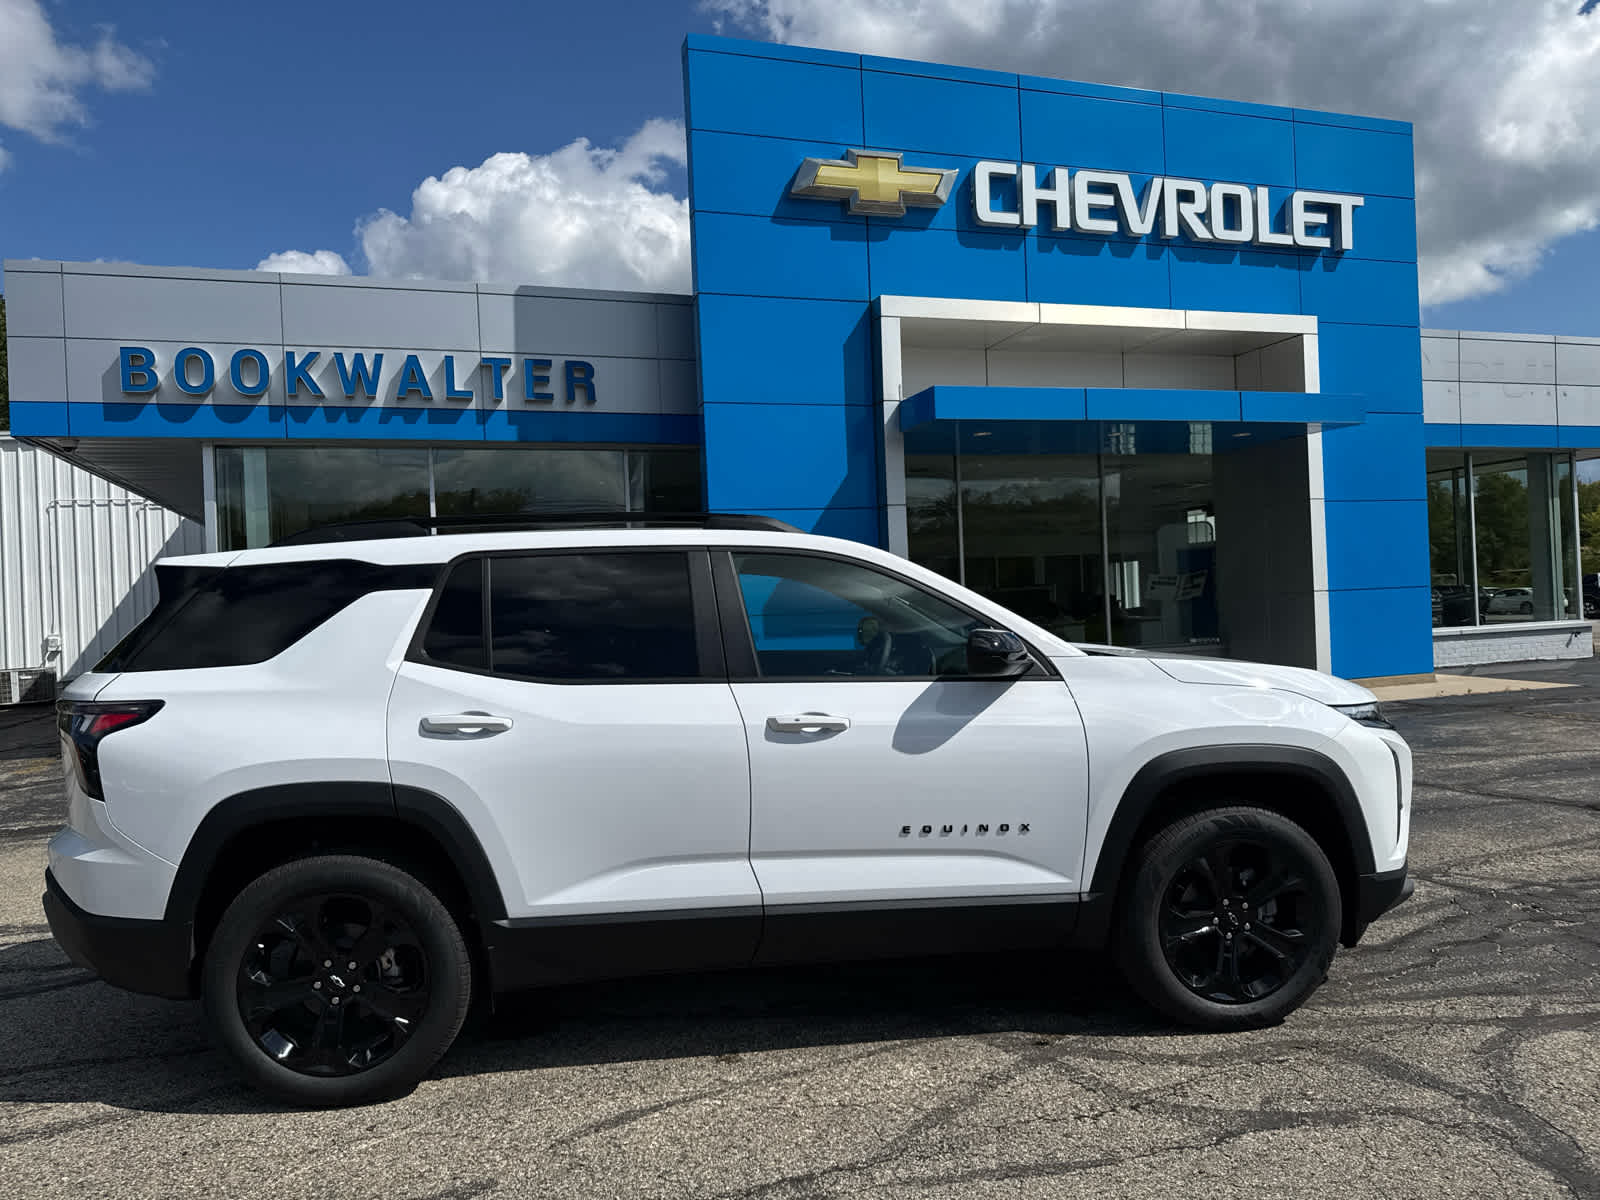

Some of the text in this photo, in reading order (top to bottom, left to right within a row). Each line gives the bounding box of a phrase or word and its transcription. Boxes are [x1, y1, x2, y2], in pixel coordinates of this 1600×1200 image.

[972, 161, 1364, 251] CHEVROLET
[119, 345, 596, 402] BOOKWALTER
[901, 823, 1030, 835] EQUINOX
